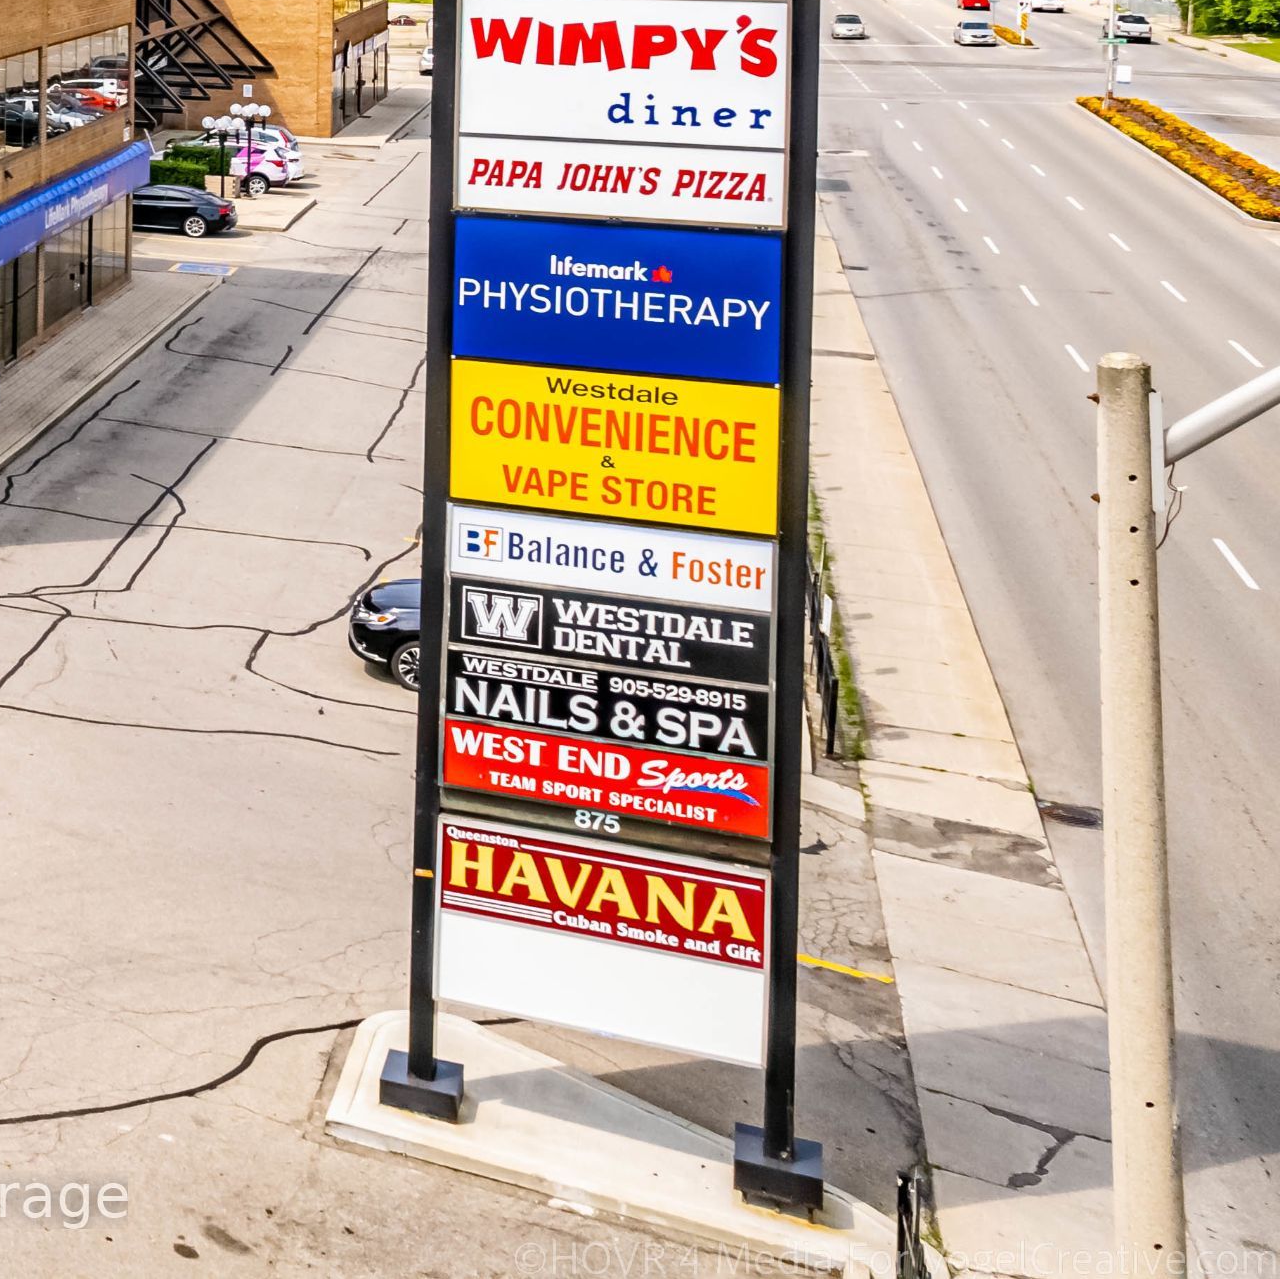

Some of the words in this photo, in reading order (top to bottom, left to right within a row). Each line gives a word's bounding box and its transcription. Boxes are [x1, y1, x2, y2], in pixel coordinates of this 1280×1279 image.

[470, 14, 778, 78] WIMPY'S
[607, 92, 772, 130] diner
[468, 158, 542, 189] PAPA
[557, 163, 661, 196] JOHN'S
[672, 169, 767, 202] PIZZA
[550, 254, 648, 282] lifemark
[458, 278, 771, 331] PHYSIOTHERAPY
[546, 376, 679, 406] Westdale
[470, 396, 757, 463] CONVENIENCE
[600, 455, 616, 469] &
[502, 464, 589, 501] VAPE
[601, 476, 717, 516] STORE
[507, 532, 626, 574] Balance
[638, 548, 659, 578] &
[671, 550, 767, 590] Foster
[467, 590, 539, 642] W
[552, 598, 755, 649] WESTDALE
[553, 626, 691, 669] DENTAL
[462, 656, 598, 690] WESTDALE
[609, 676, 747, 711] 905-529-8915
[453, 676, 600, 733] NAILS
[609, 701, 646, 740] &
[655, 707, 758, 757] SPA
[451, 726, 547, 767] WEST
[558, 743, 632, 781] END
[636, 759, 749, 795] Sports
[489, 770, 537, 792] TEAM
[542, 780, 604, 804] SPORT
[608, 791, 718, 823] SPECIALIST
[574, 808, 622, 834] 875
[446, 826, 520, 849] Queenston
[448, 839, 757, 943] HAVANA
[552, 910, 612, 936] Cuban
[616, 922, 680, 949] Smoke
[683, 937, 721, 957] and
[725, 942, 763, 964] Gift
